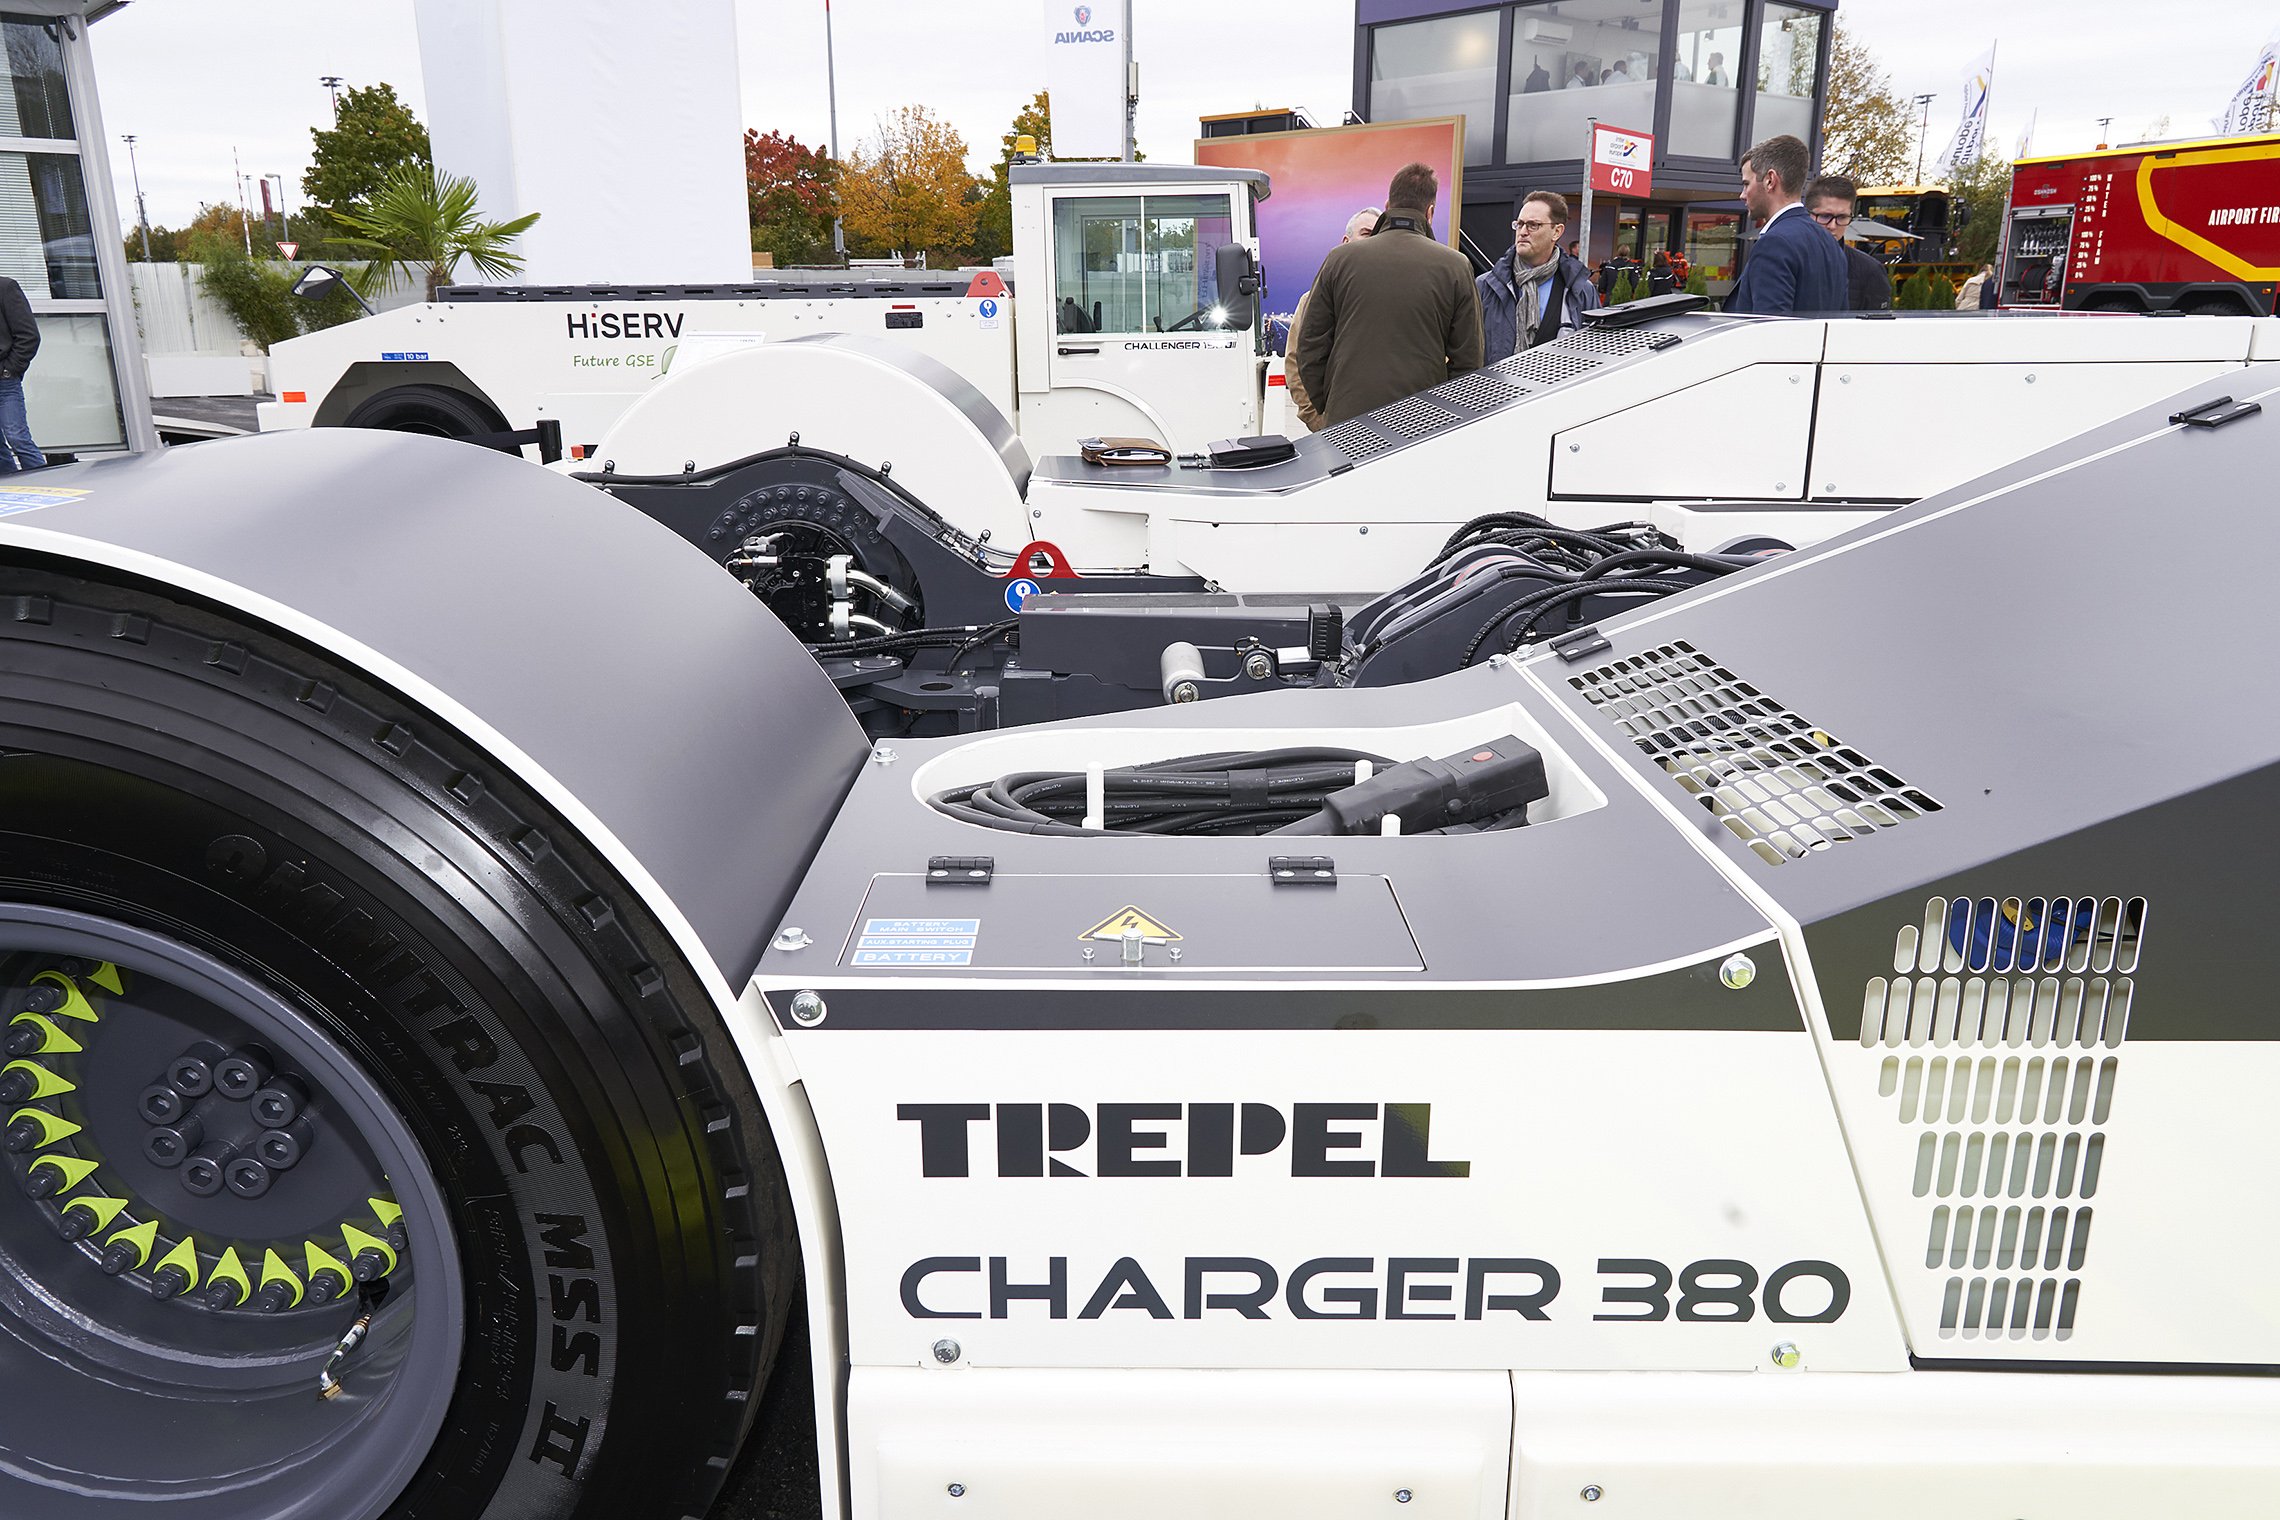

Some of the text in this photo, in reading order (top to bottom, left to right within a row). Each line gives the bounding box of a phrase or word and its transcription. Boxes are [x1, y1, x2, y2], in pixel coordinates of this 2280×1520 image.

[1611, 168, 1633, 188] C70
[2208, 206, 2280, 226] AIRPORT FIR
[567, 313, 684, 339] HiSERV
[1124, 342, 1201, 351] CHALLENGER
[574, 355, 655, 368] Future GSE
[863, 953, 960, 961] BATTERY
[896, 1102, 1472, 1178] TREPEL
[899, 1256, 1852, 1323] CHARGER 380
